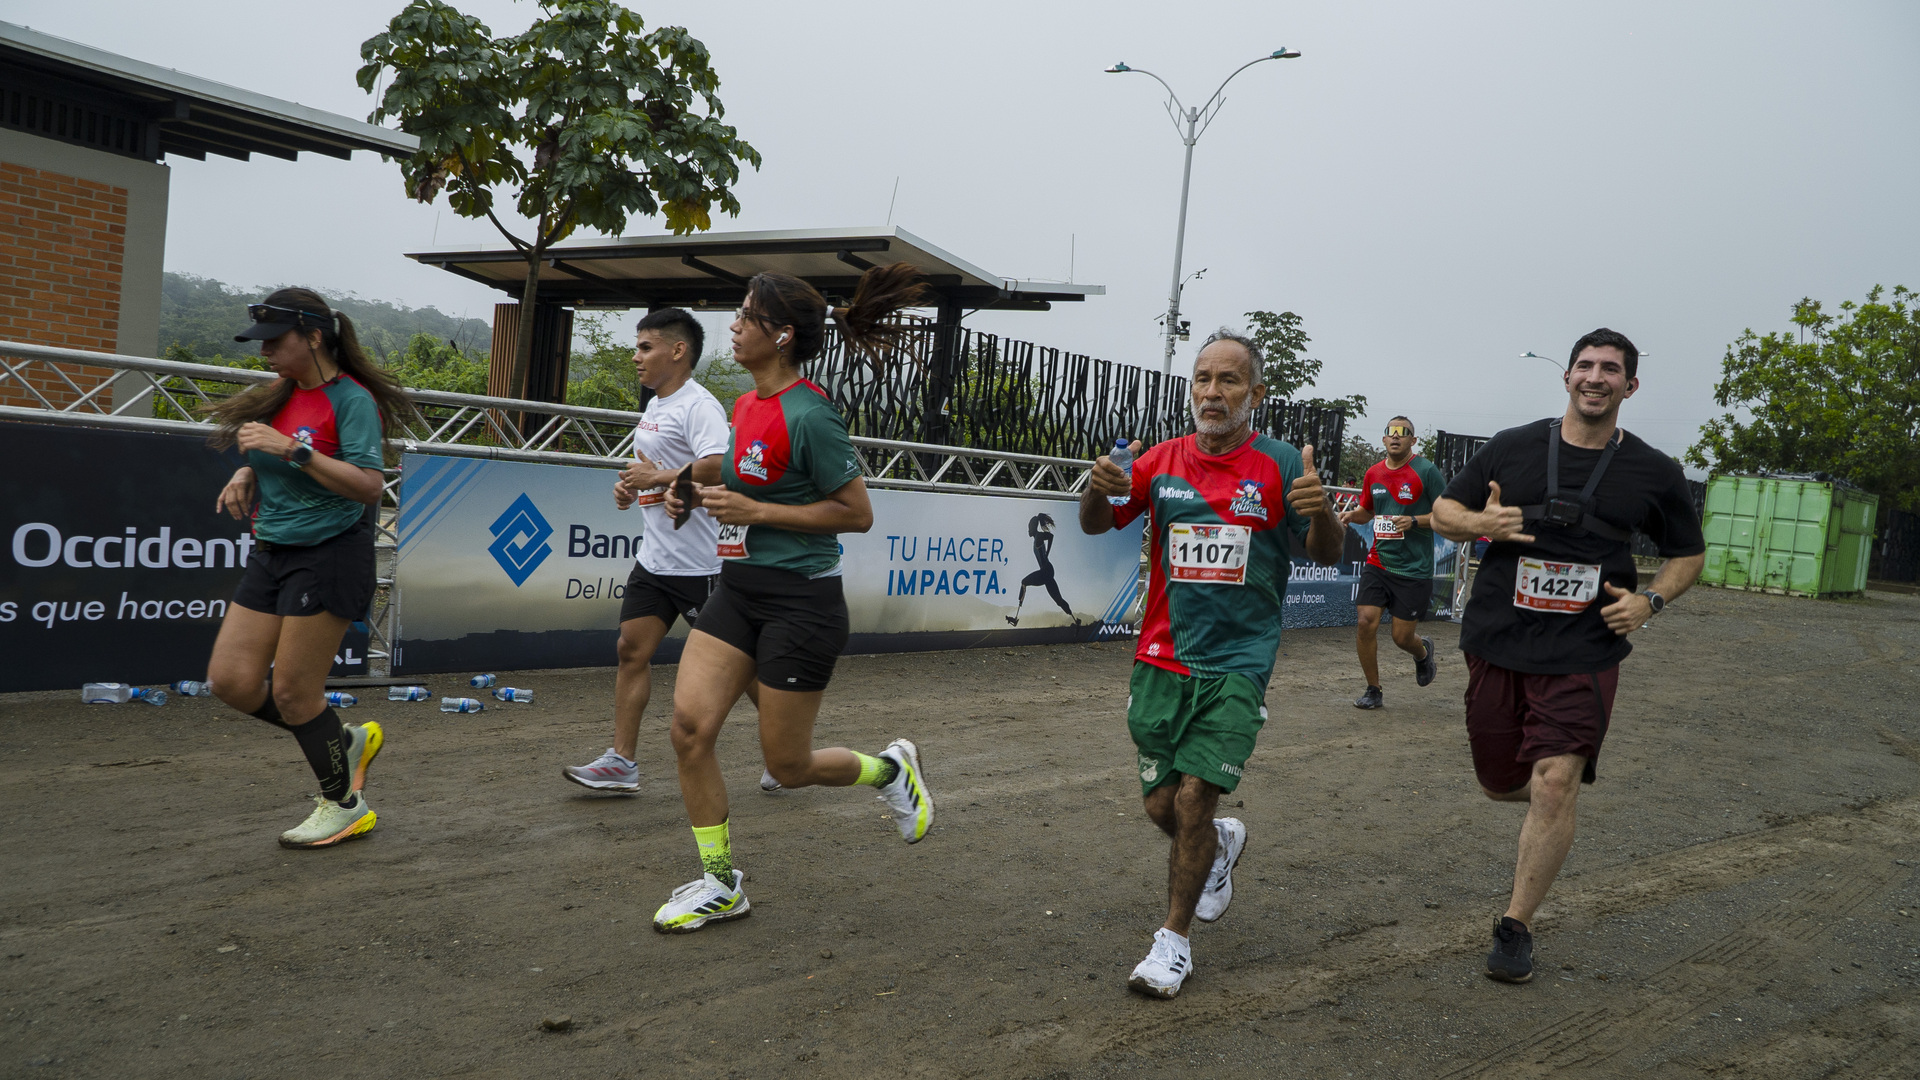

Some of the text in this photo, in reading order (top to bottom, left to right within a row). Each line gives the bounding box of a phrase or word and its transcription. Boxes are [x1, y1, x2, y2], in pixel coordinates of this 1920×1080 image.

[12, 522, 256, 569] Occident
[568, 524, 644, 559] Banc
[887, 536, 1008, 566] TU HACER,
[1179, 542, 1234, 564] 1107
[565, 577, 627, 600] Del la
[887, 569, 1007, 596] IMPACTA.
[1530, 576, 1584, 597] 1427
[1286, 594, 1300, 607] que
[31, 600, 106, 629] que
[1098, 623, 1132, 635] AVAL
[326, 738, 344, 775] SPORT
